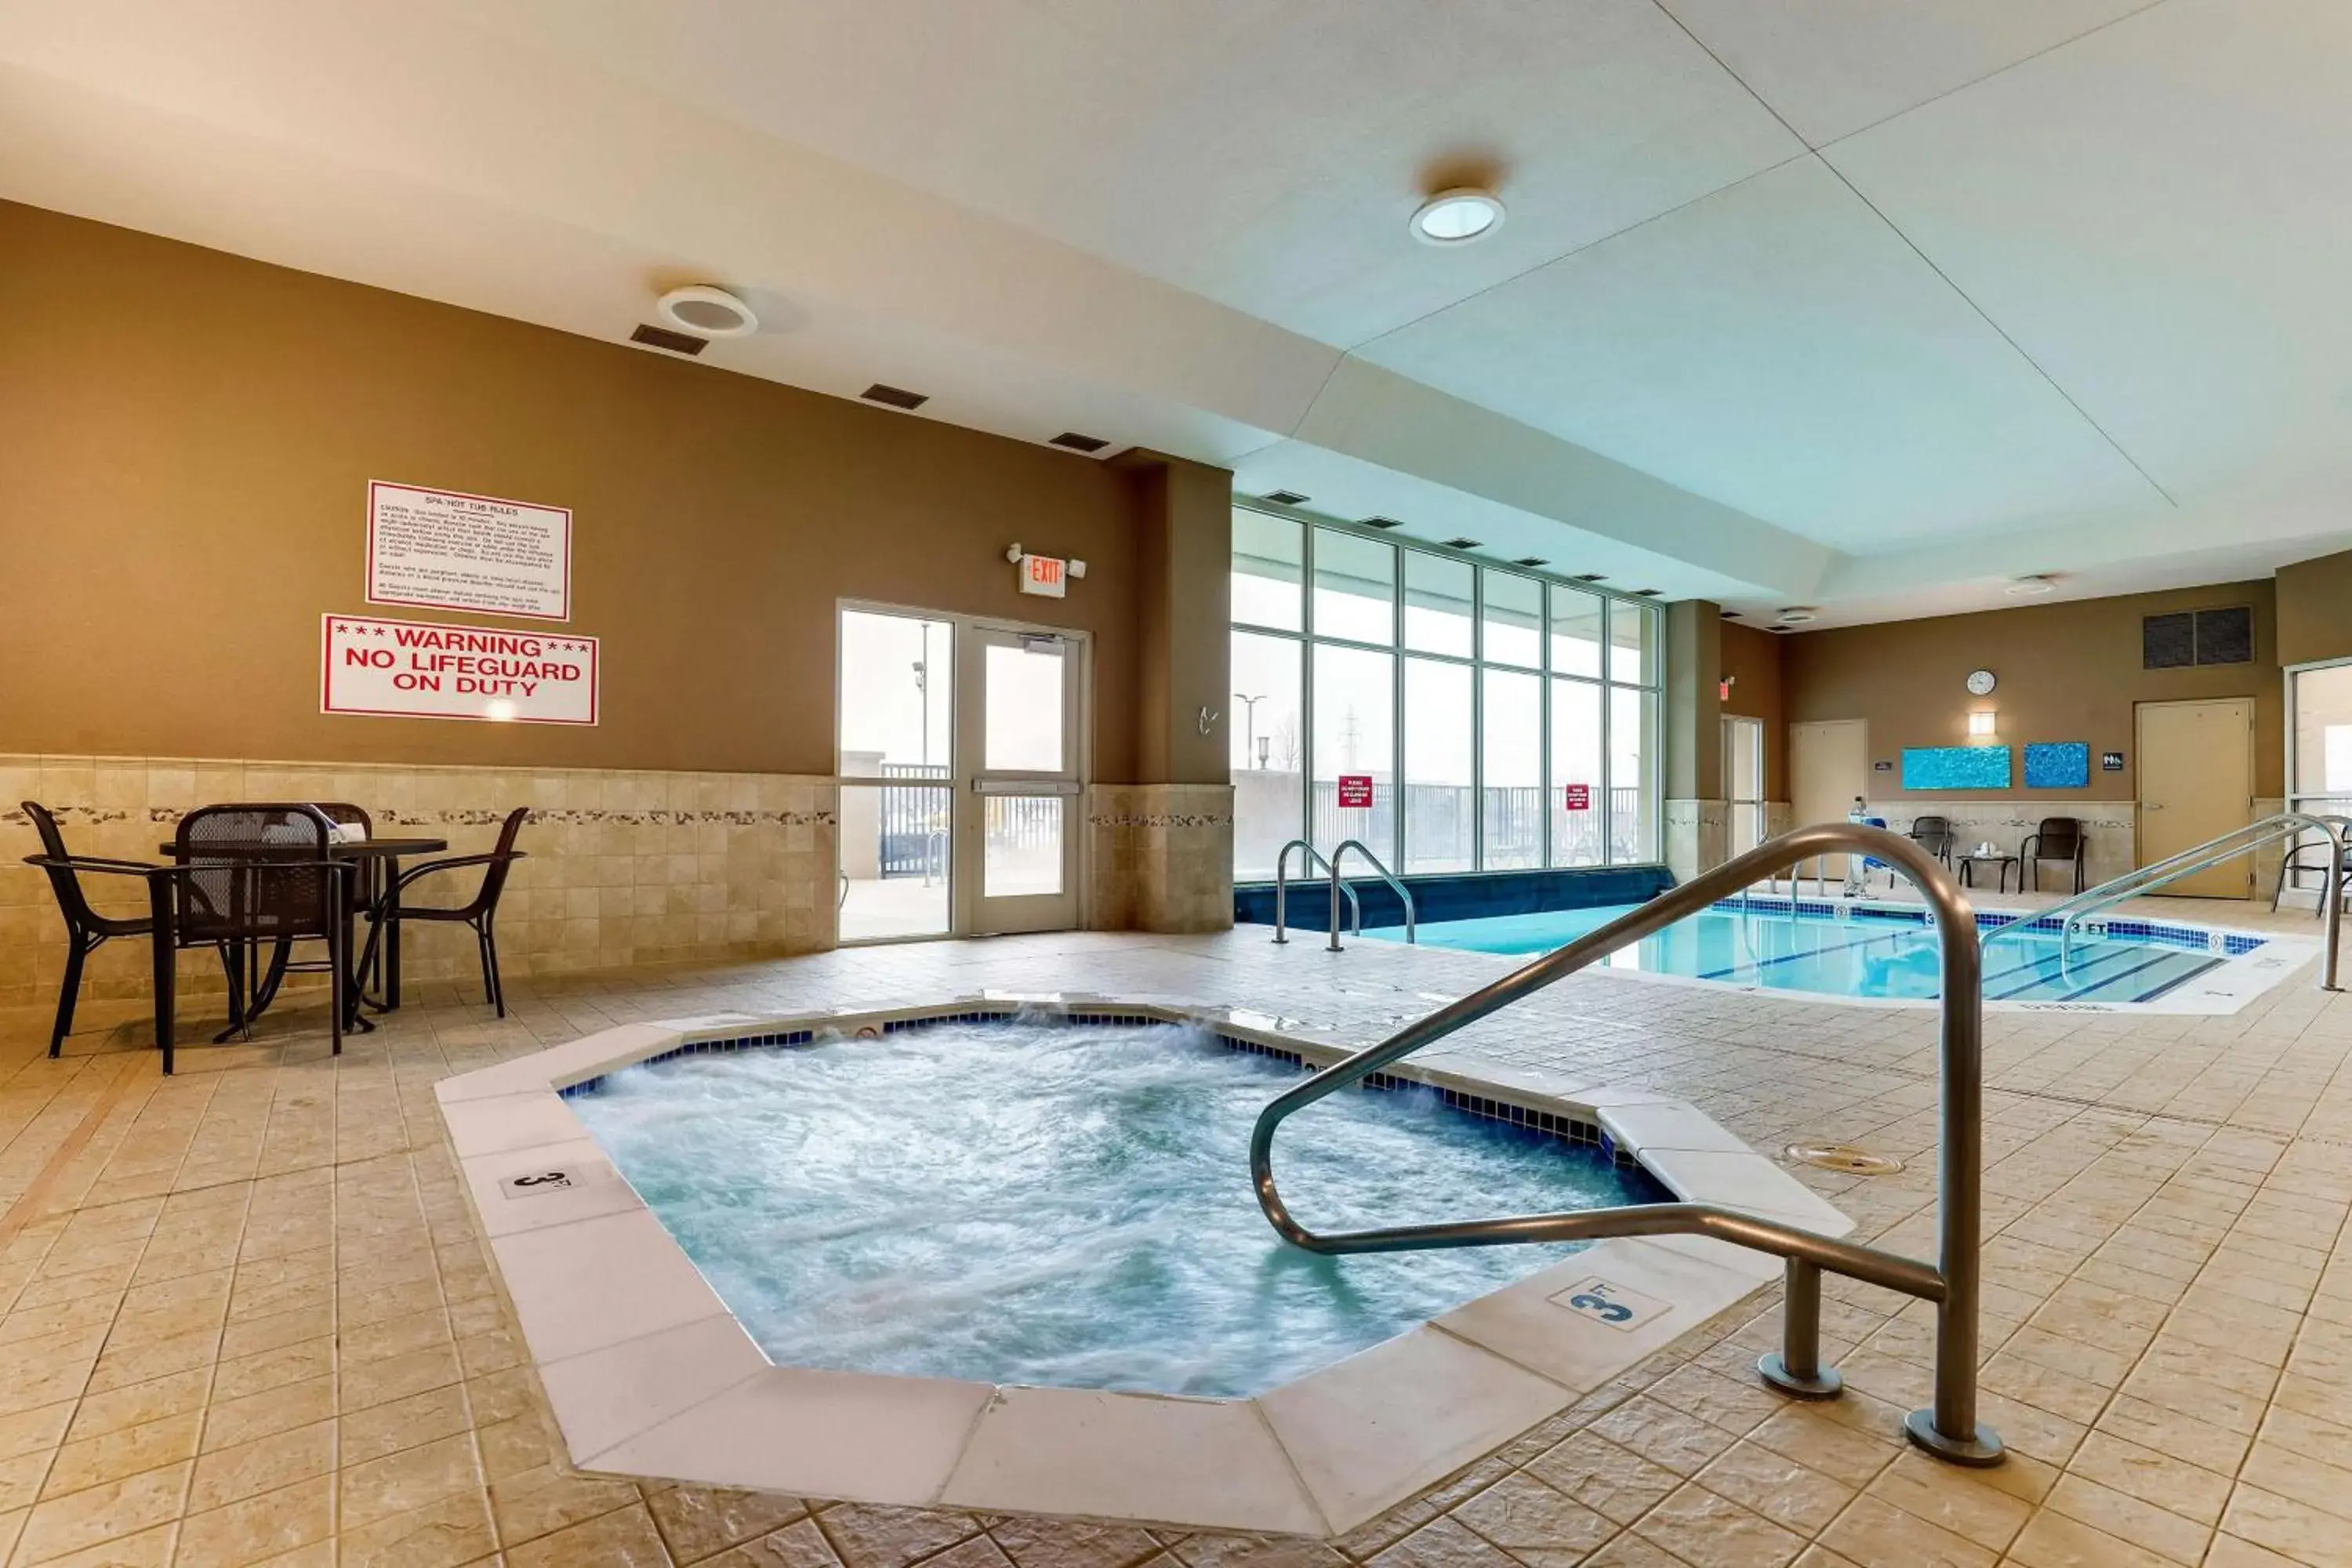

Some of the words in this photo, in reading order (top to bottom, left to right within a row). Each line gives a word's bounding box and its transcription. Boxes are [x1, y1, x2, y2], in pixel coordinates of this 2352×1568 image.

[1033, 557, 1059, 585] EXIT
[394, 628, 541, 658] WARNING
[346, 648, 395, 669] NO
[412, 652, 581, 681] LIFEGUARD
[393, 673, 441, 691] ON
[456, 677, 538, 697] DUTY
[514, 1173, 565, 1185] 3
[1570, 1294, 1633, 1322] 3
